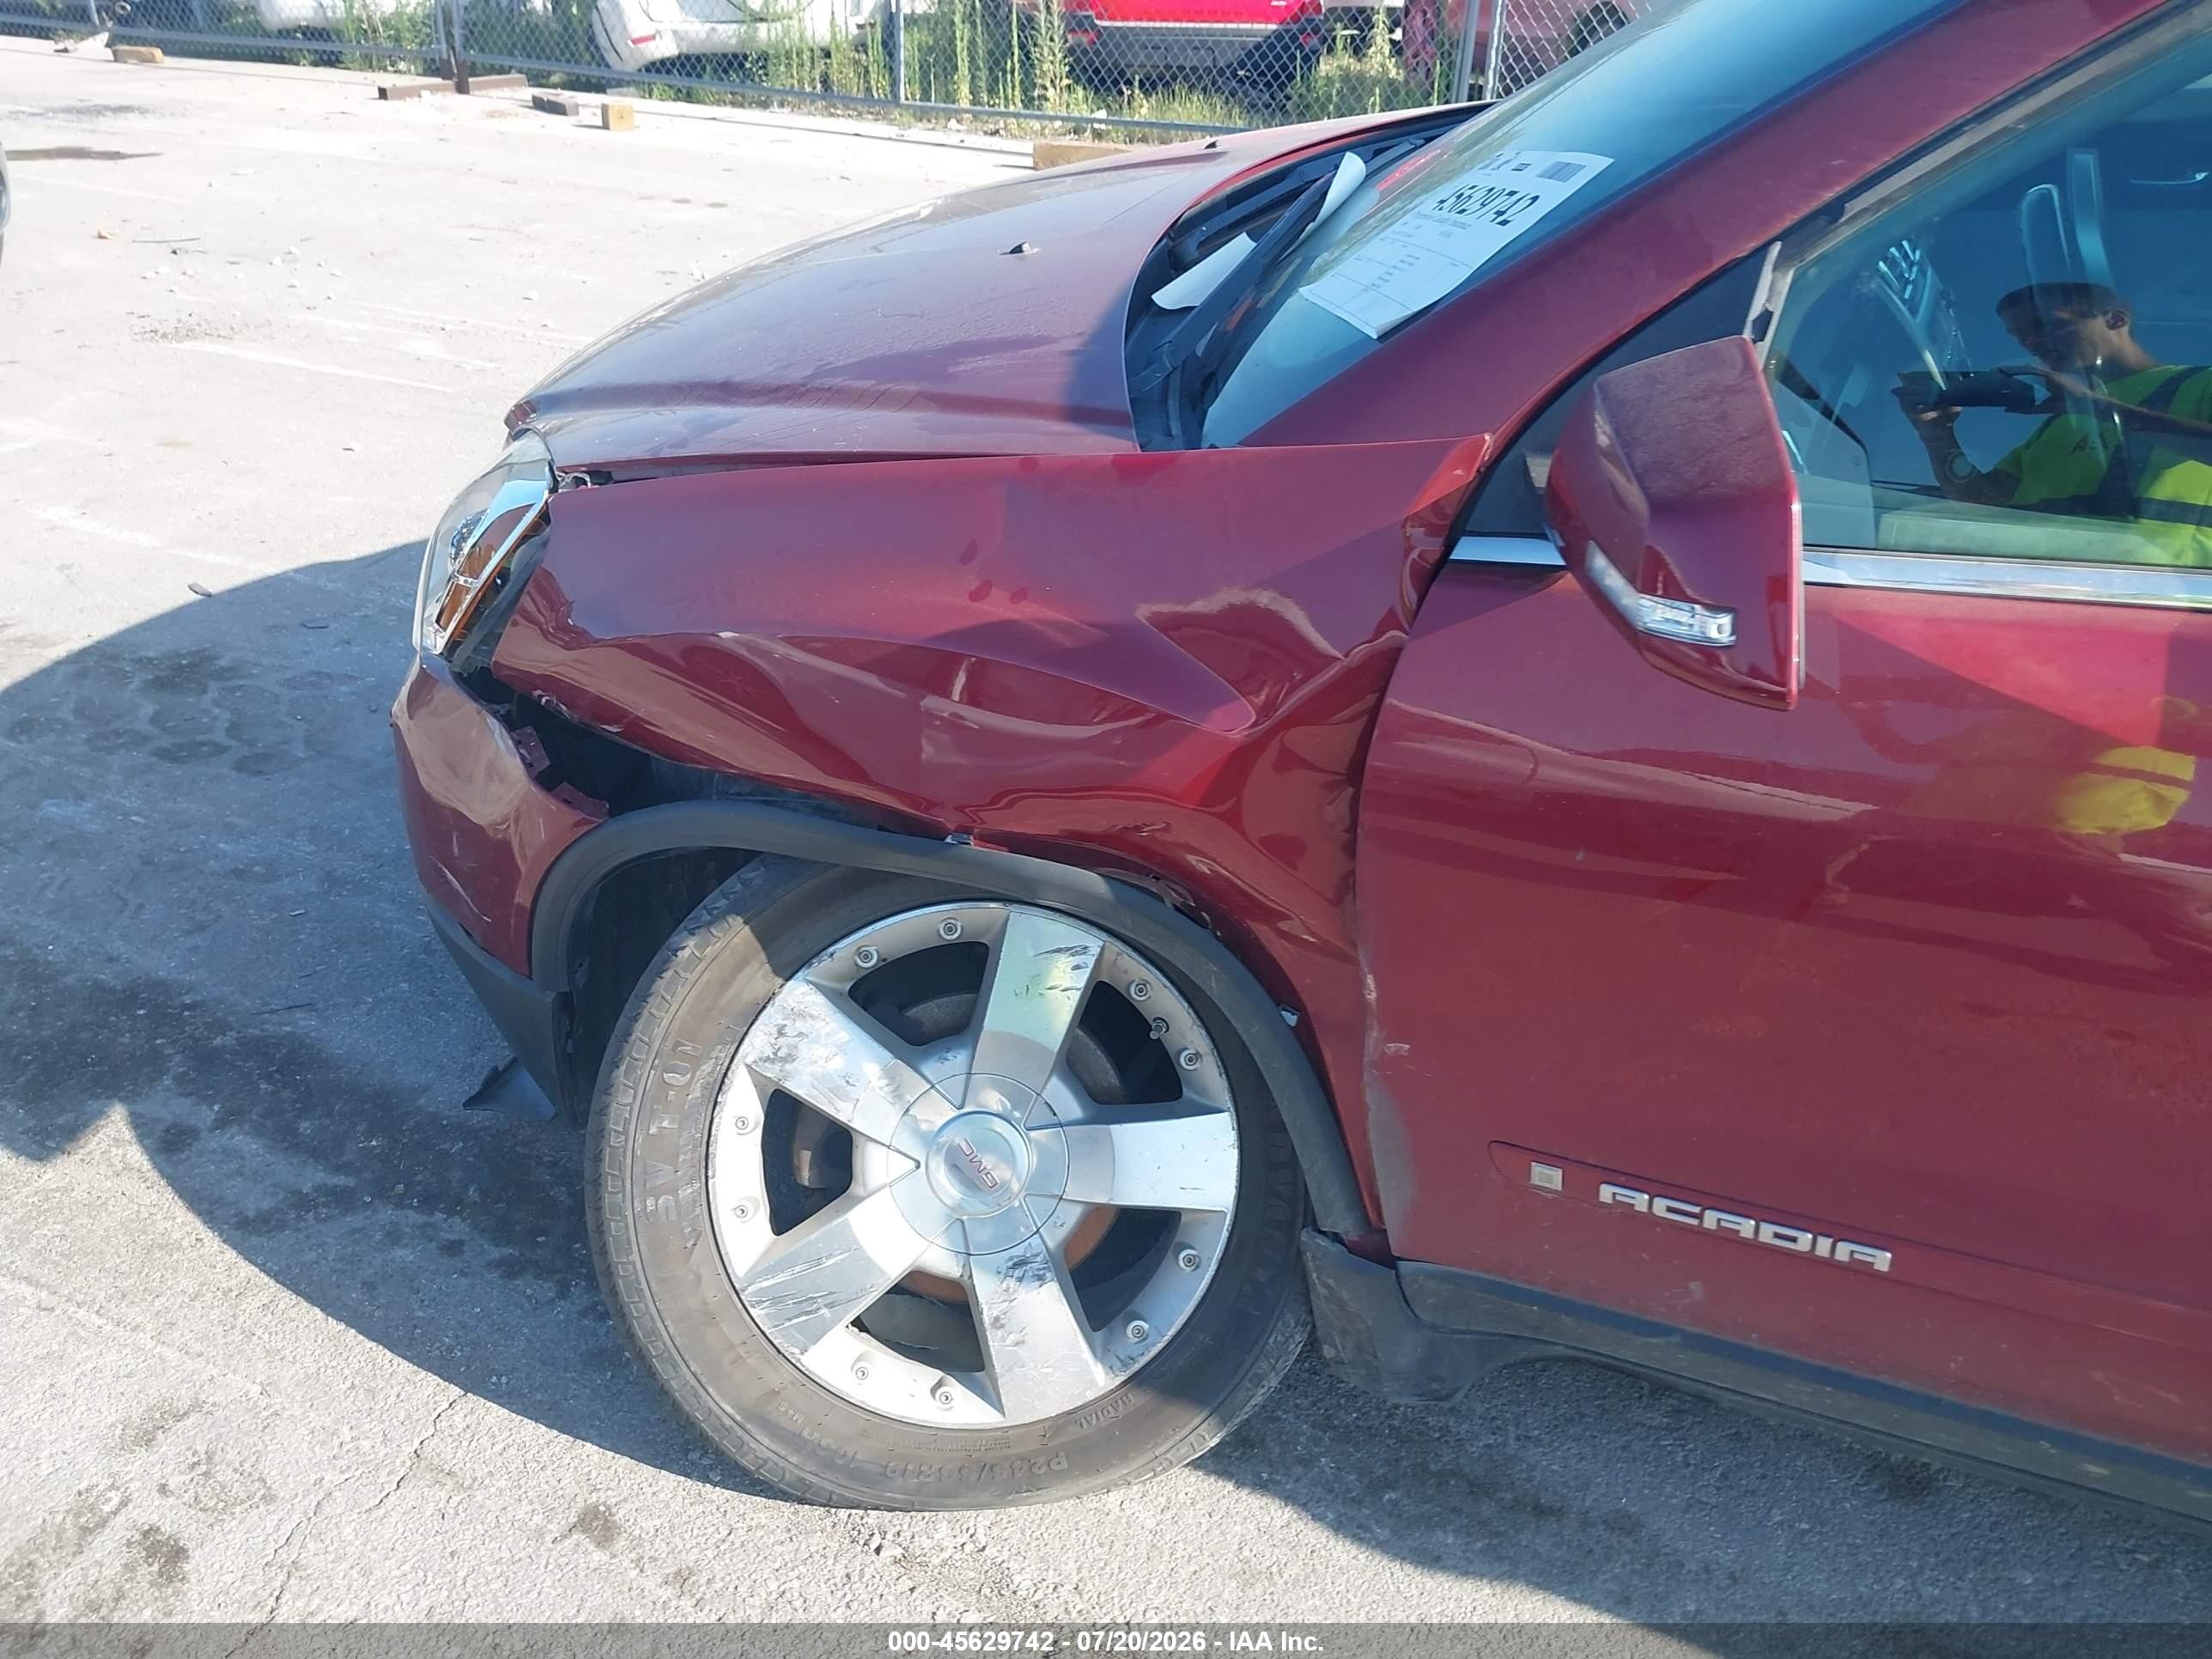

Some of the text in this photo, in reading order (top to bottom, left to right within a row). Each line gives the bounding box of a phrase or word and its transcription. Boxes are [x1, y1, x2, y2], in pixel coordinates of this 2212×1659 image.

[1431, 184, 1540, 227] 45629742
[957, 1137, 999, 1189] GMC
[1599, 1182, 1892, 1272] ACADIA
[1074, 1393, 1135, 1430] RADIAL
